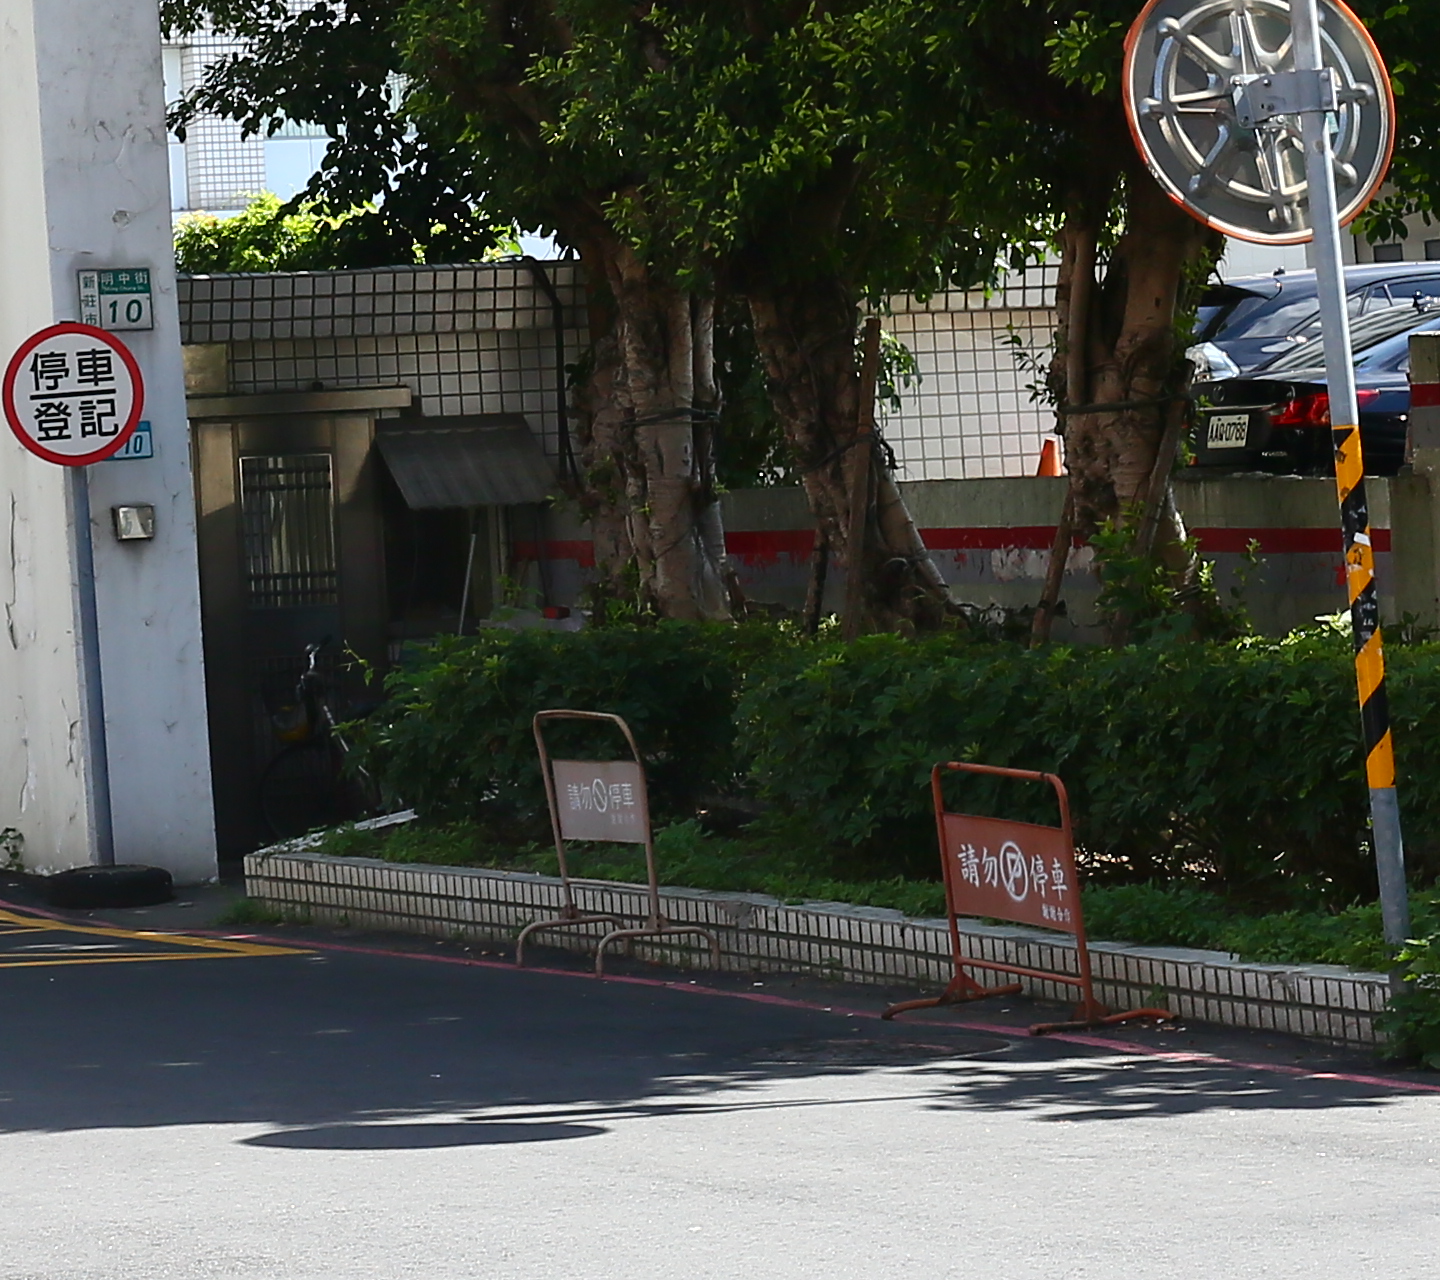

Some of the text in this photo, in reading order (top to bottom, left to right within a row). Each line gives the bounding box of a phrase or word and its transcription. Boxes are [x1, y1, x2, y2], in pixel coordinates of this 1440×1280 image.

[100, 271, 148, 286] 明中街
[108, 299, 143, 324] 10
[29, 348, 116, 391] 停車
[33, 397, 120, 442] 登記
